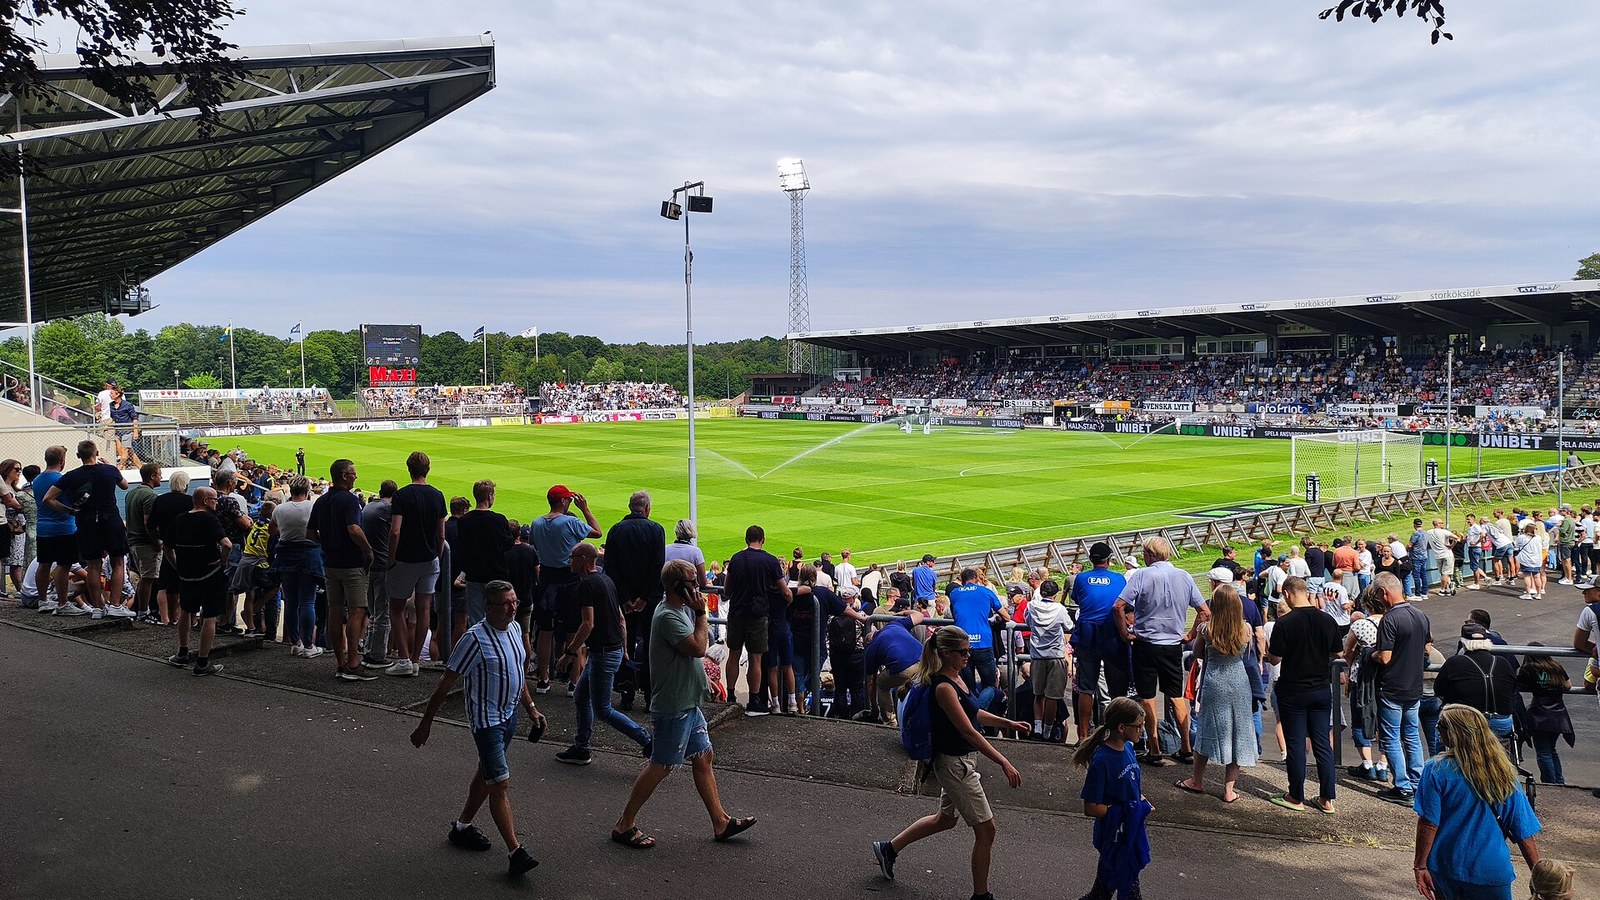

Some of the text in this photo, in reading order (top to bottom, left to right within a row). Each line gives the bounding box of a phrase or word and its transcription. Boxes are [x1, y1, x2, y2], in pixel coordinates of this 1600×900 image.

[1142, 402, 1172, 410] SVENSKA
[1173, 402, 1191, 411] LYFT
[1382, 405, 1396, 413] VVS
[761, 411, 780, 419] UNIBET
[806, 412, 827, 421] UNIBET
[861, 415, 884, 423] UNIBET
[204, 426, 247, 437] villalivet
[1115, 423, 1152, 433] UNIBET
[1479, 434, 1543, 449] UNIBET
[1555, 440, 1579, 449] SPELA
[1090, 577, 1110, 585] EAB
[822, 703, 831, 717] 7
